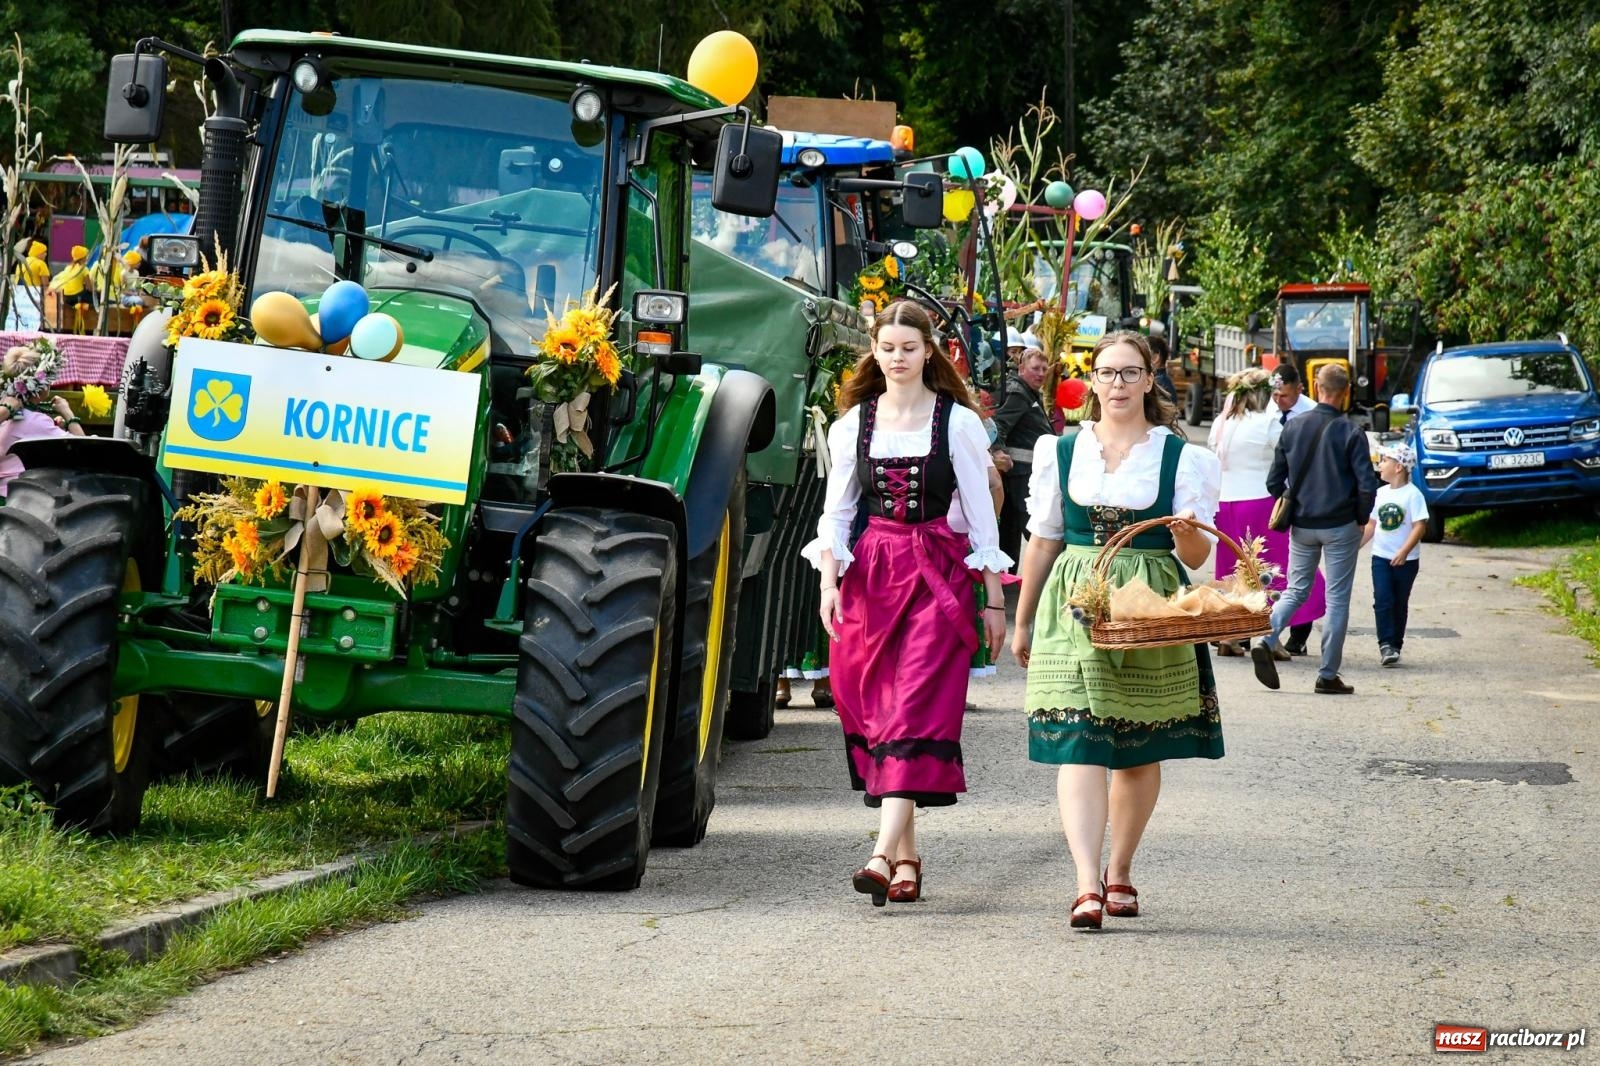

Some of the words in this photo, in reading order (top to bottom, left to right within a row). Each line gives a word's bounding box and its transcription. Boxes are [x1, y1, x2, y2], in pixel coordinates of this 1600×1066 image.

[283, 397, 431, 453] KORNICE
[1494, 456, 1506, 467] OK
[1511, 454, 1542, 465] 3223C
